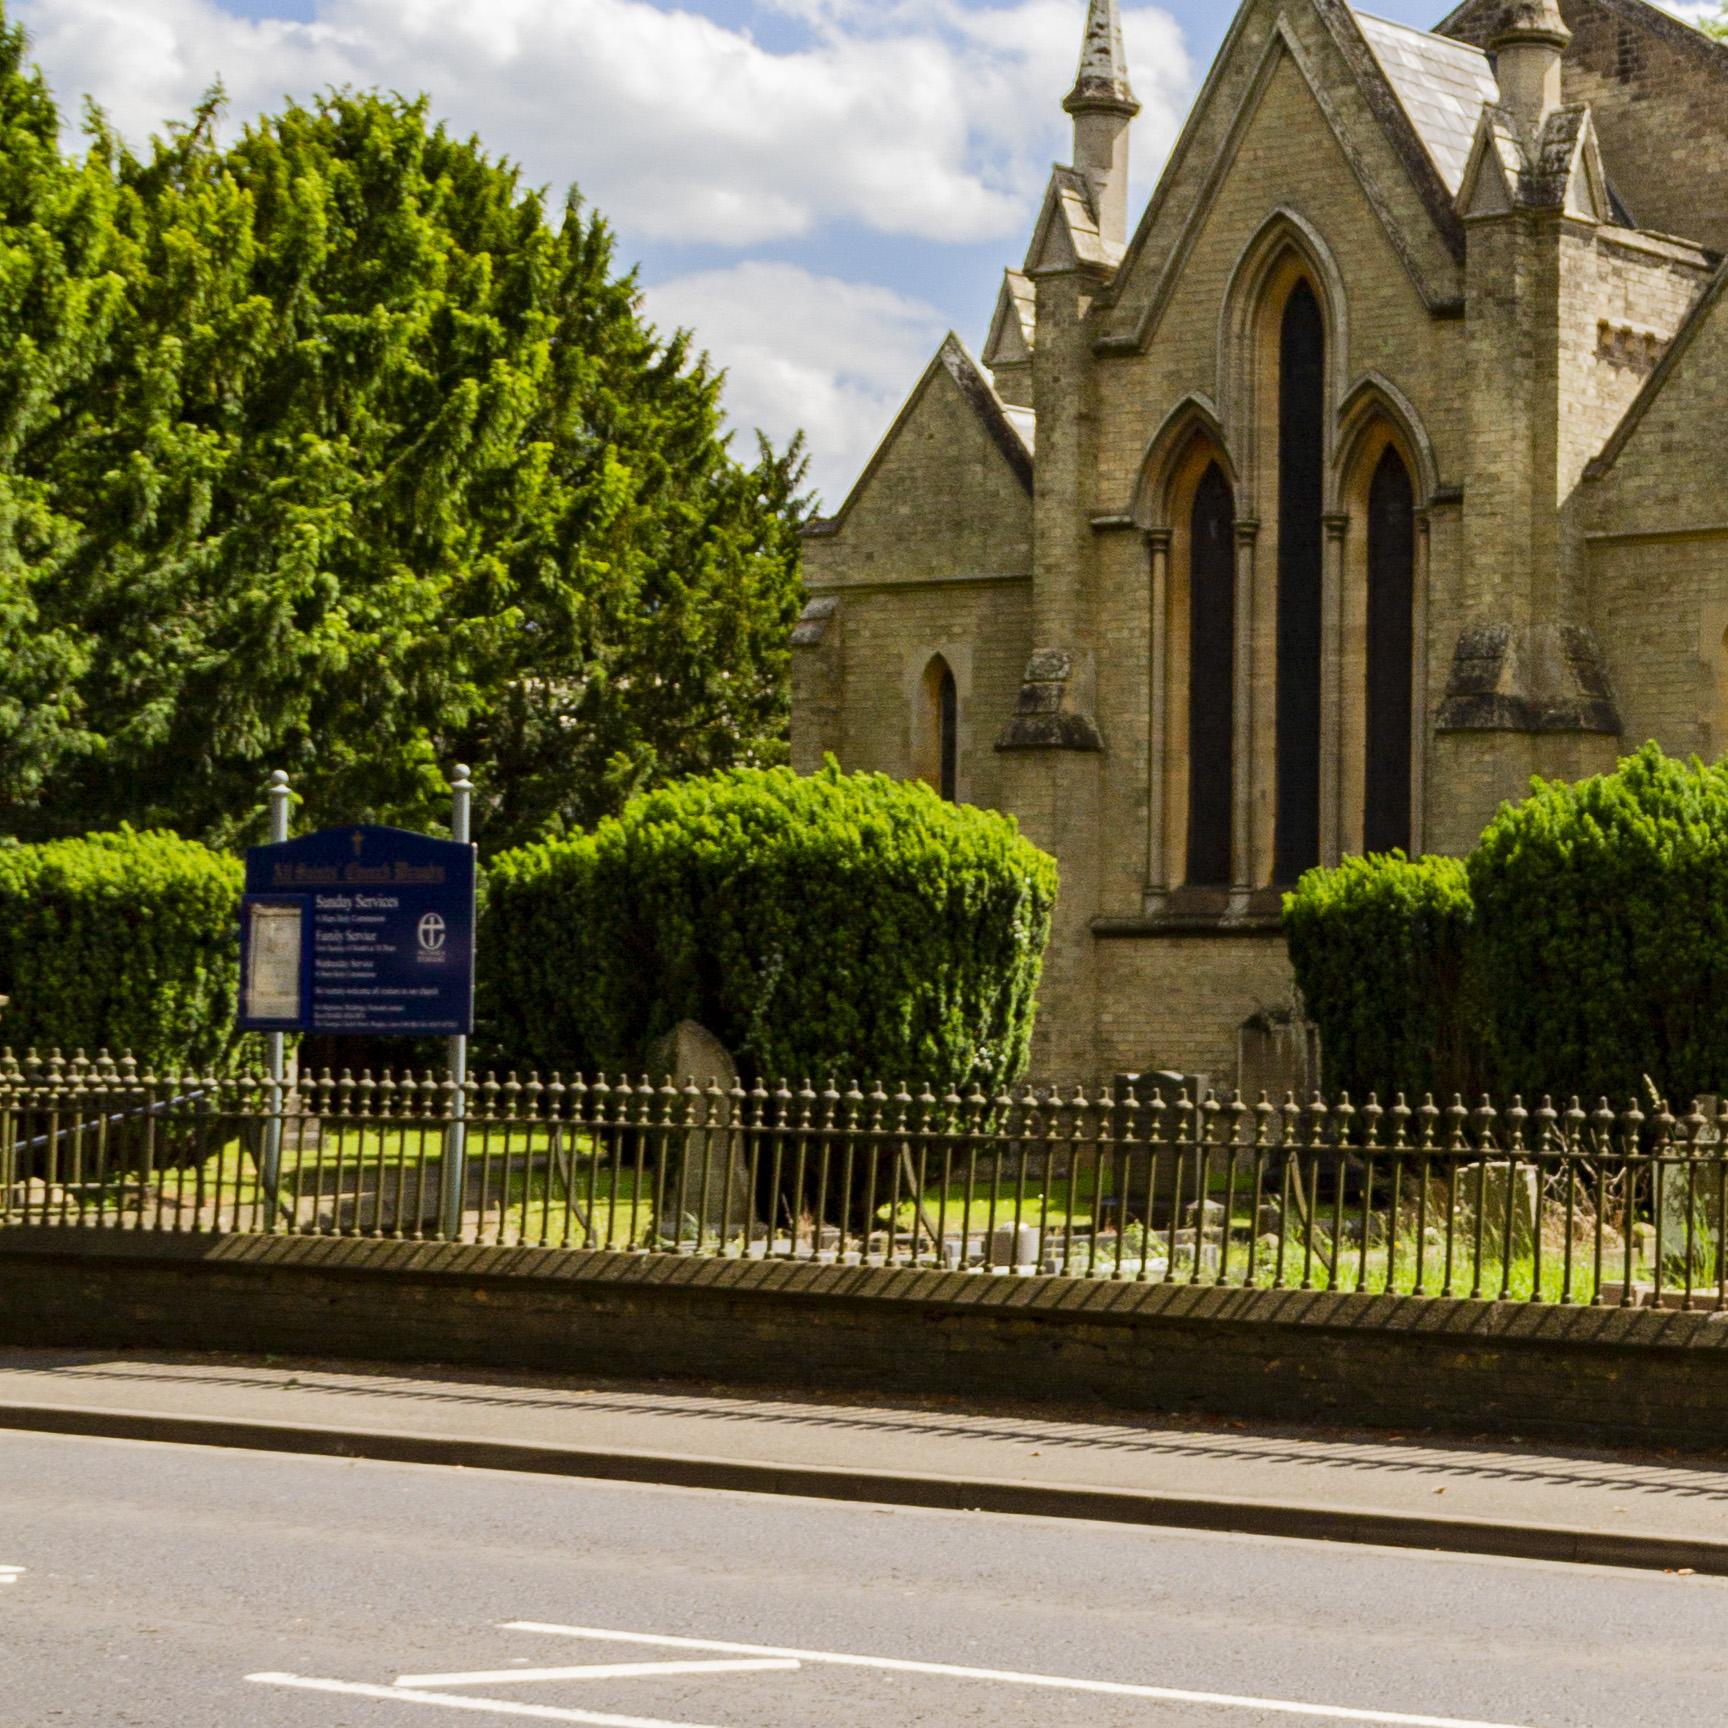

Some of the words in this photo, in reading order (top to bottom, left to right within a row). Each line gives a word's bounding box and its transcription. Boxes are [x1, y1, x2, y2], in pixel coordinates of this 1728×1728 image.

[315, 894, 352, 910] Sunday
[355, 894, 400, 908] Services
[345, 930, 377, 942] Service
